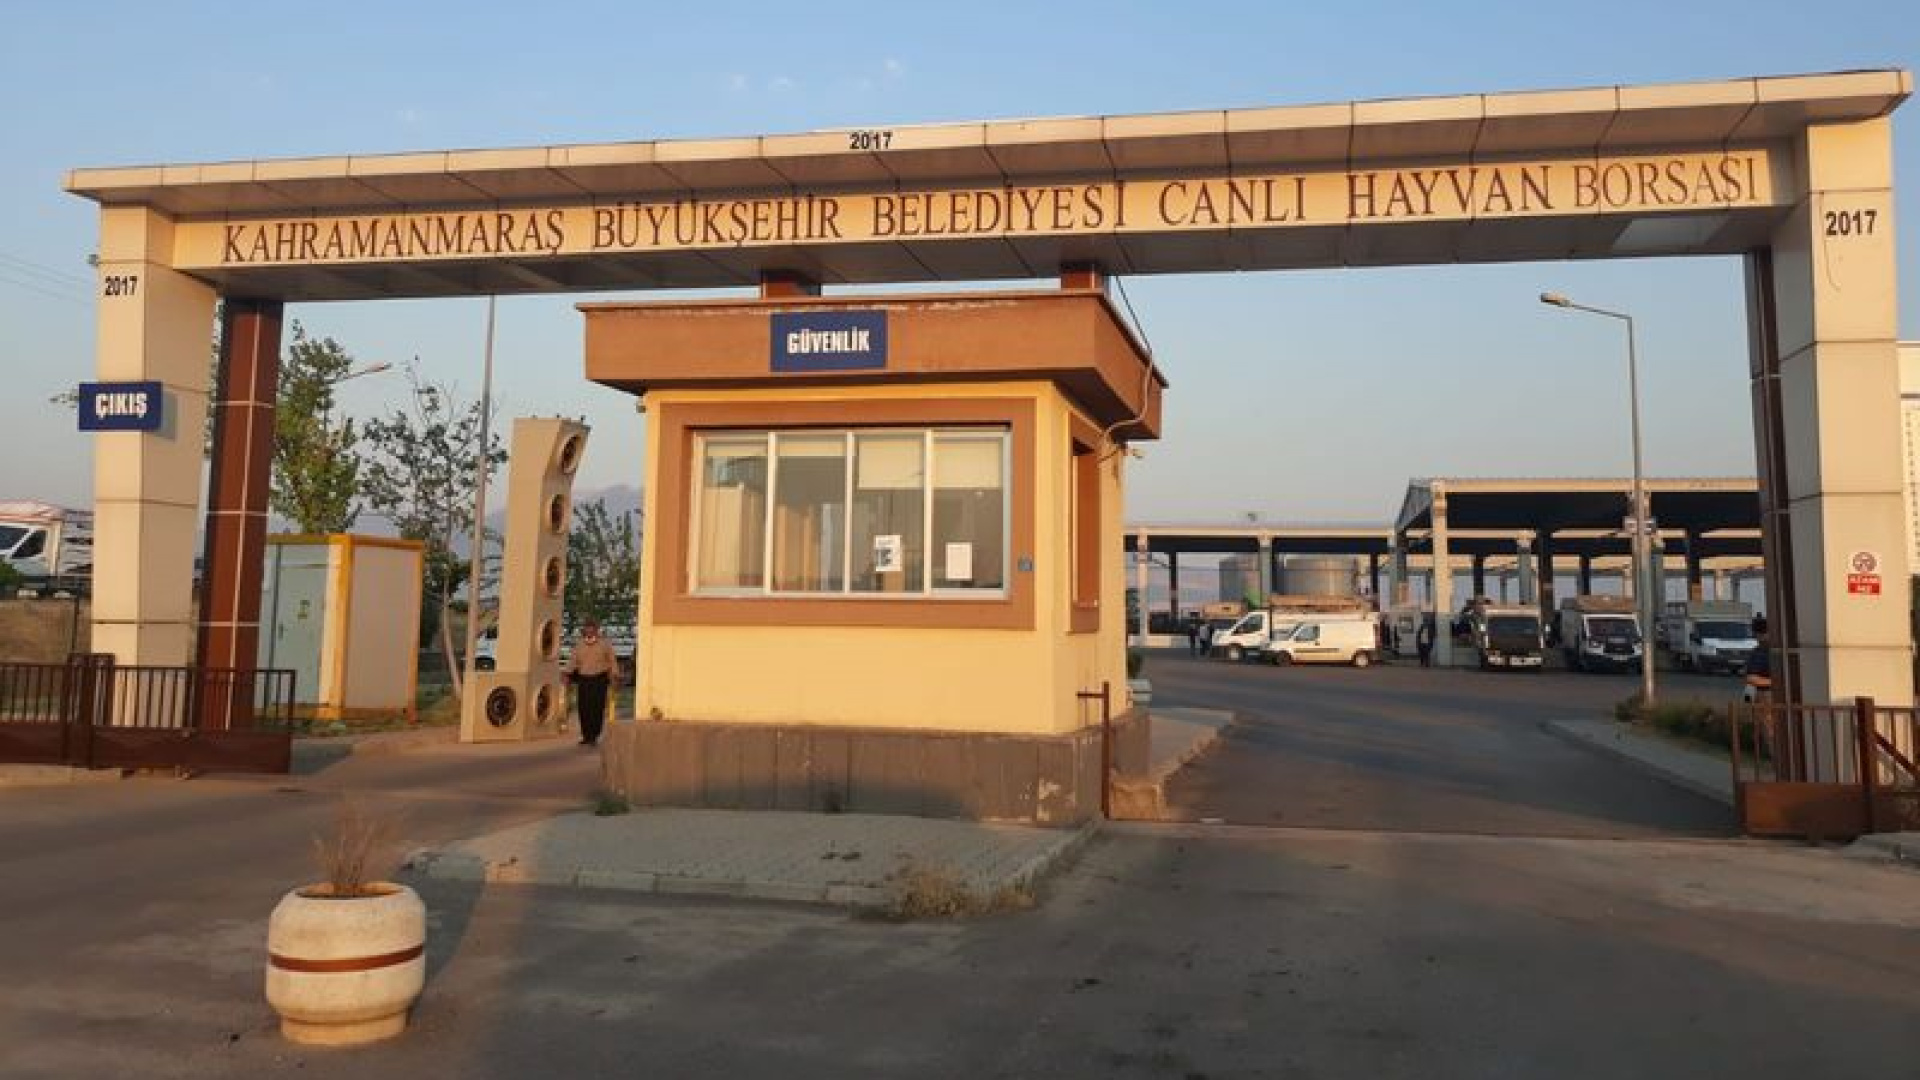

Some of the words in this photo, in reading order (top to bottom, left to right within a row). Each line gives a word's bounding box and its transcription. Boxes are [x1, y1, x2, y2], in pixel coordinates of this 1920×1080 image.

[849, 131, 893, 150] 2017
[222, 209, 565, 263] KAHRAMANMARAŞ
[593, 193, 842, 248] BÜYÜKŞEHİR
[872, 180, 1126, 236] BELEDİYESİ
[1158, 177, 1307, 226] CANLI
[1347, 165, 1555, 219] HAYVAN
[1573, 156, 1758, 207] BORSASI
[1825, 209, 1877, 235] 2017
[104, 275, 138, 296] 2017
[786, 326, 870, 353] GÜVENLİK
[95, 392, 148, 419] ÇIKIŞ
